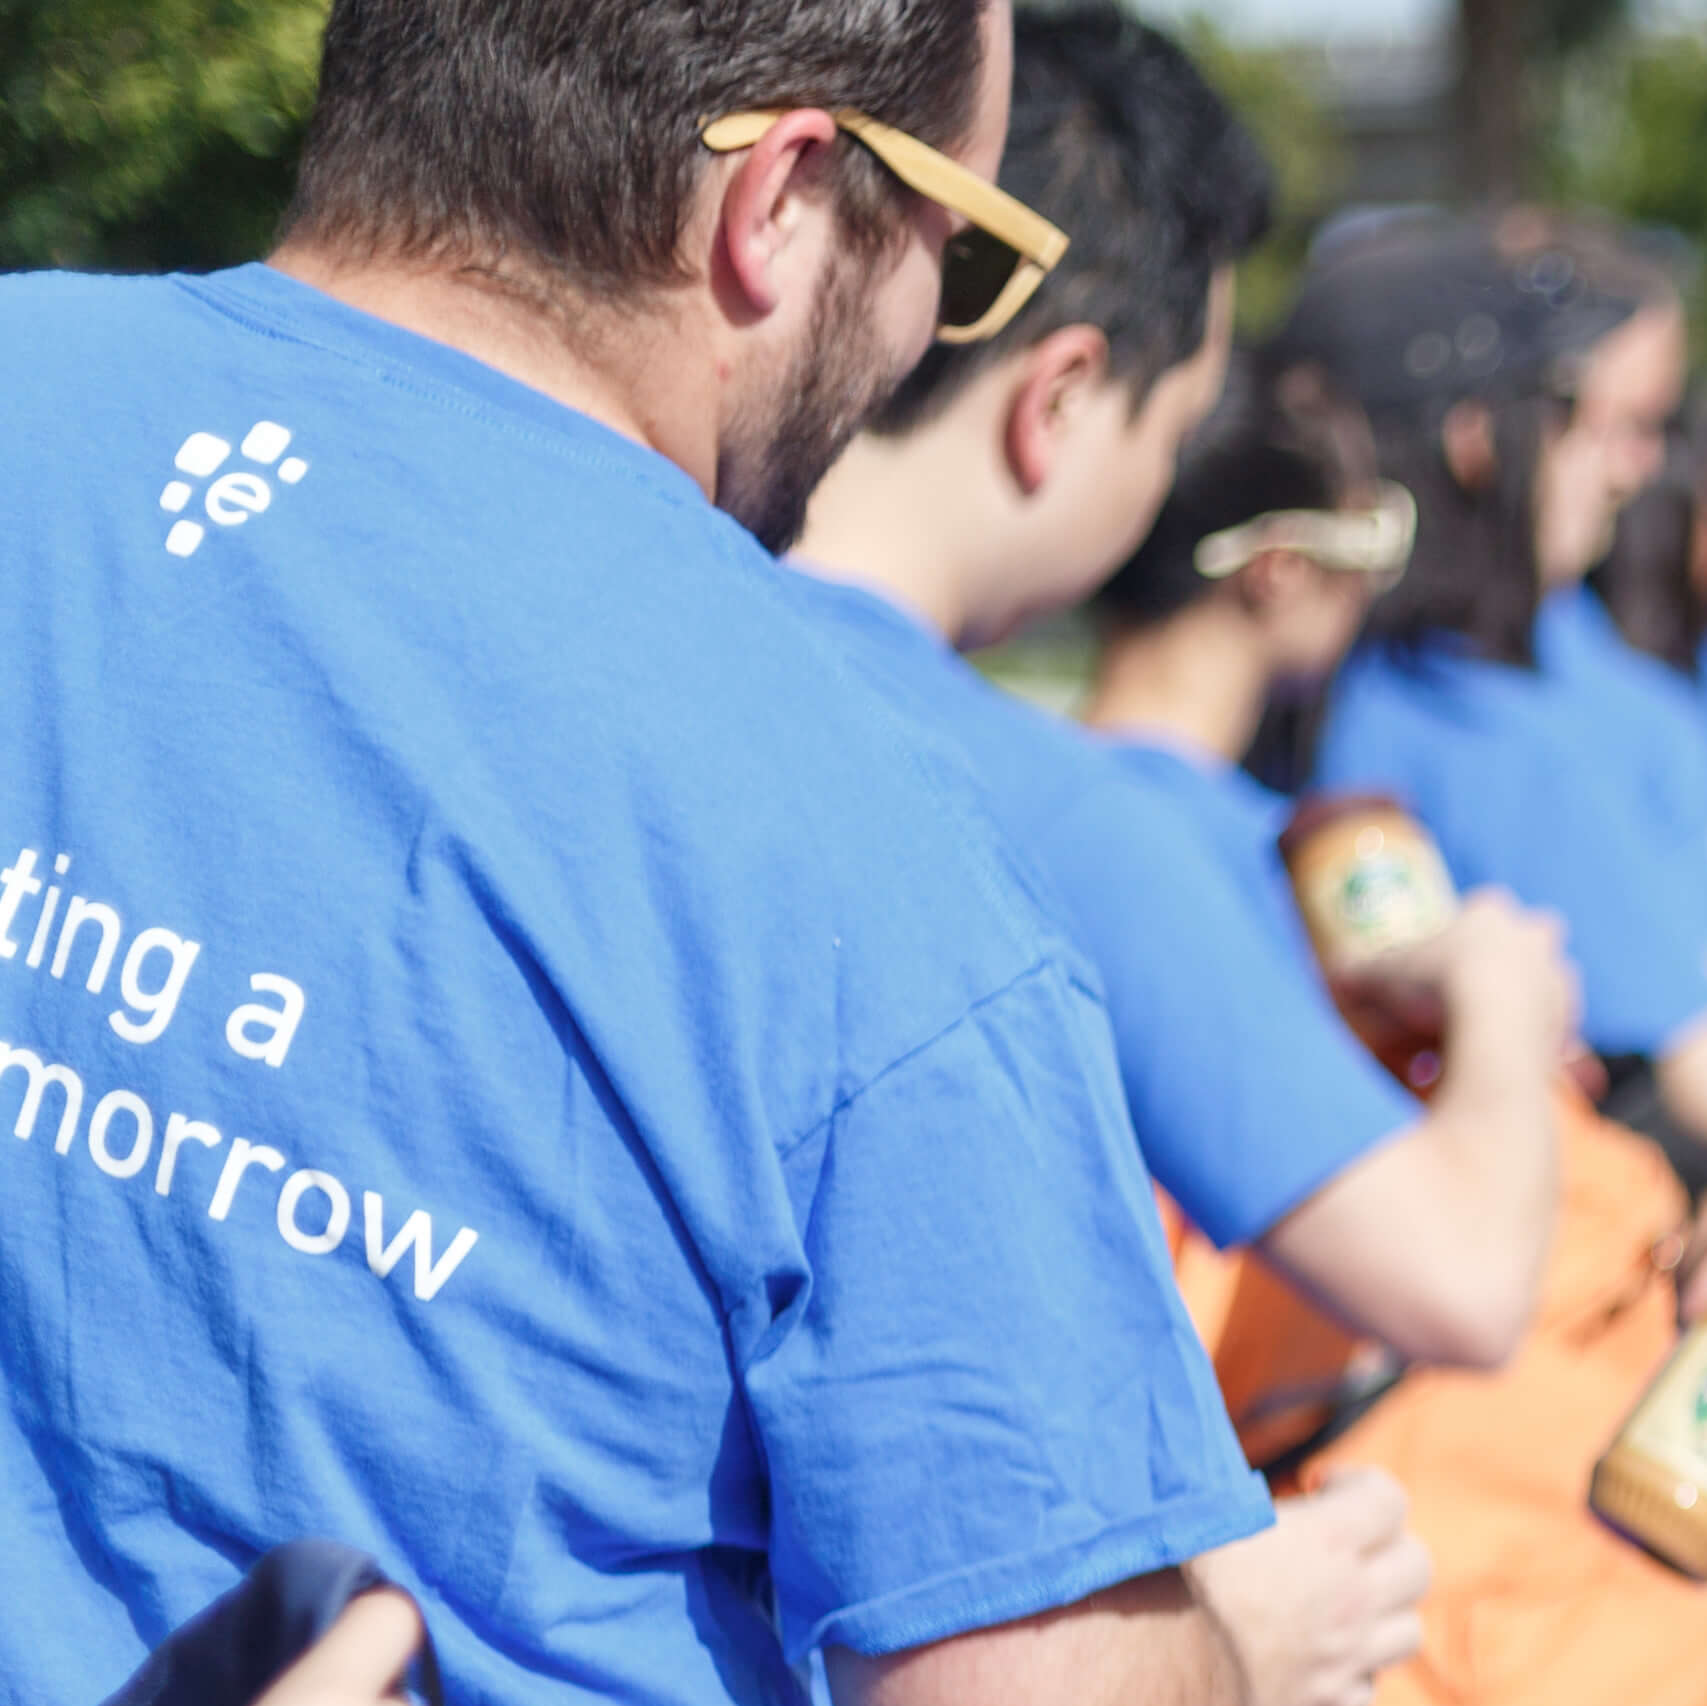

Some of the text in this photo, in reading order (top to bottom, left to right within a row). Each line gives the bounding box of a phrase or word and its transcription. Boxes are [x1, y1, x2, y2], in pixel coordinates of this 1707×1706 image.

[204, 470, 273, 526] e
[0, 848, 305, 1068] ting a
[0, 1040, 479, 1301] morrow
